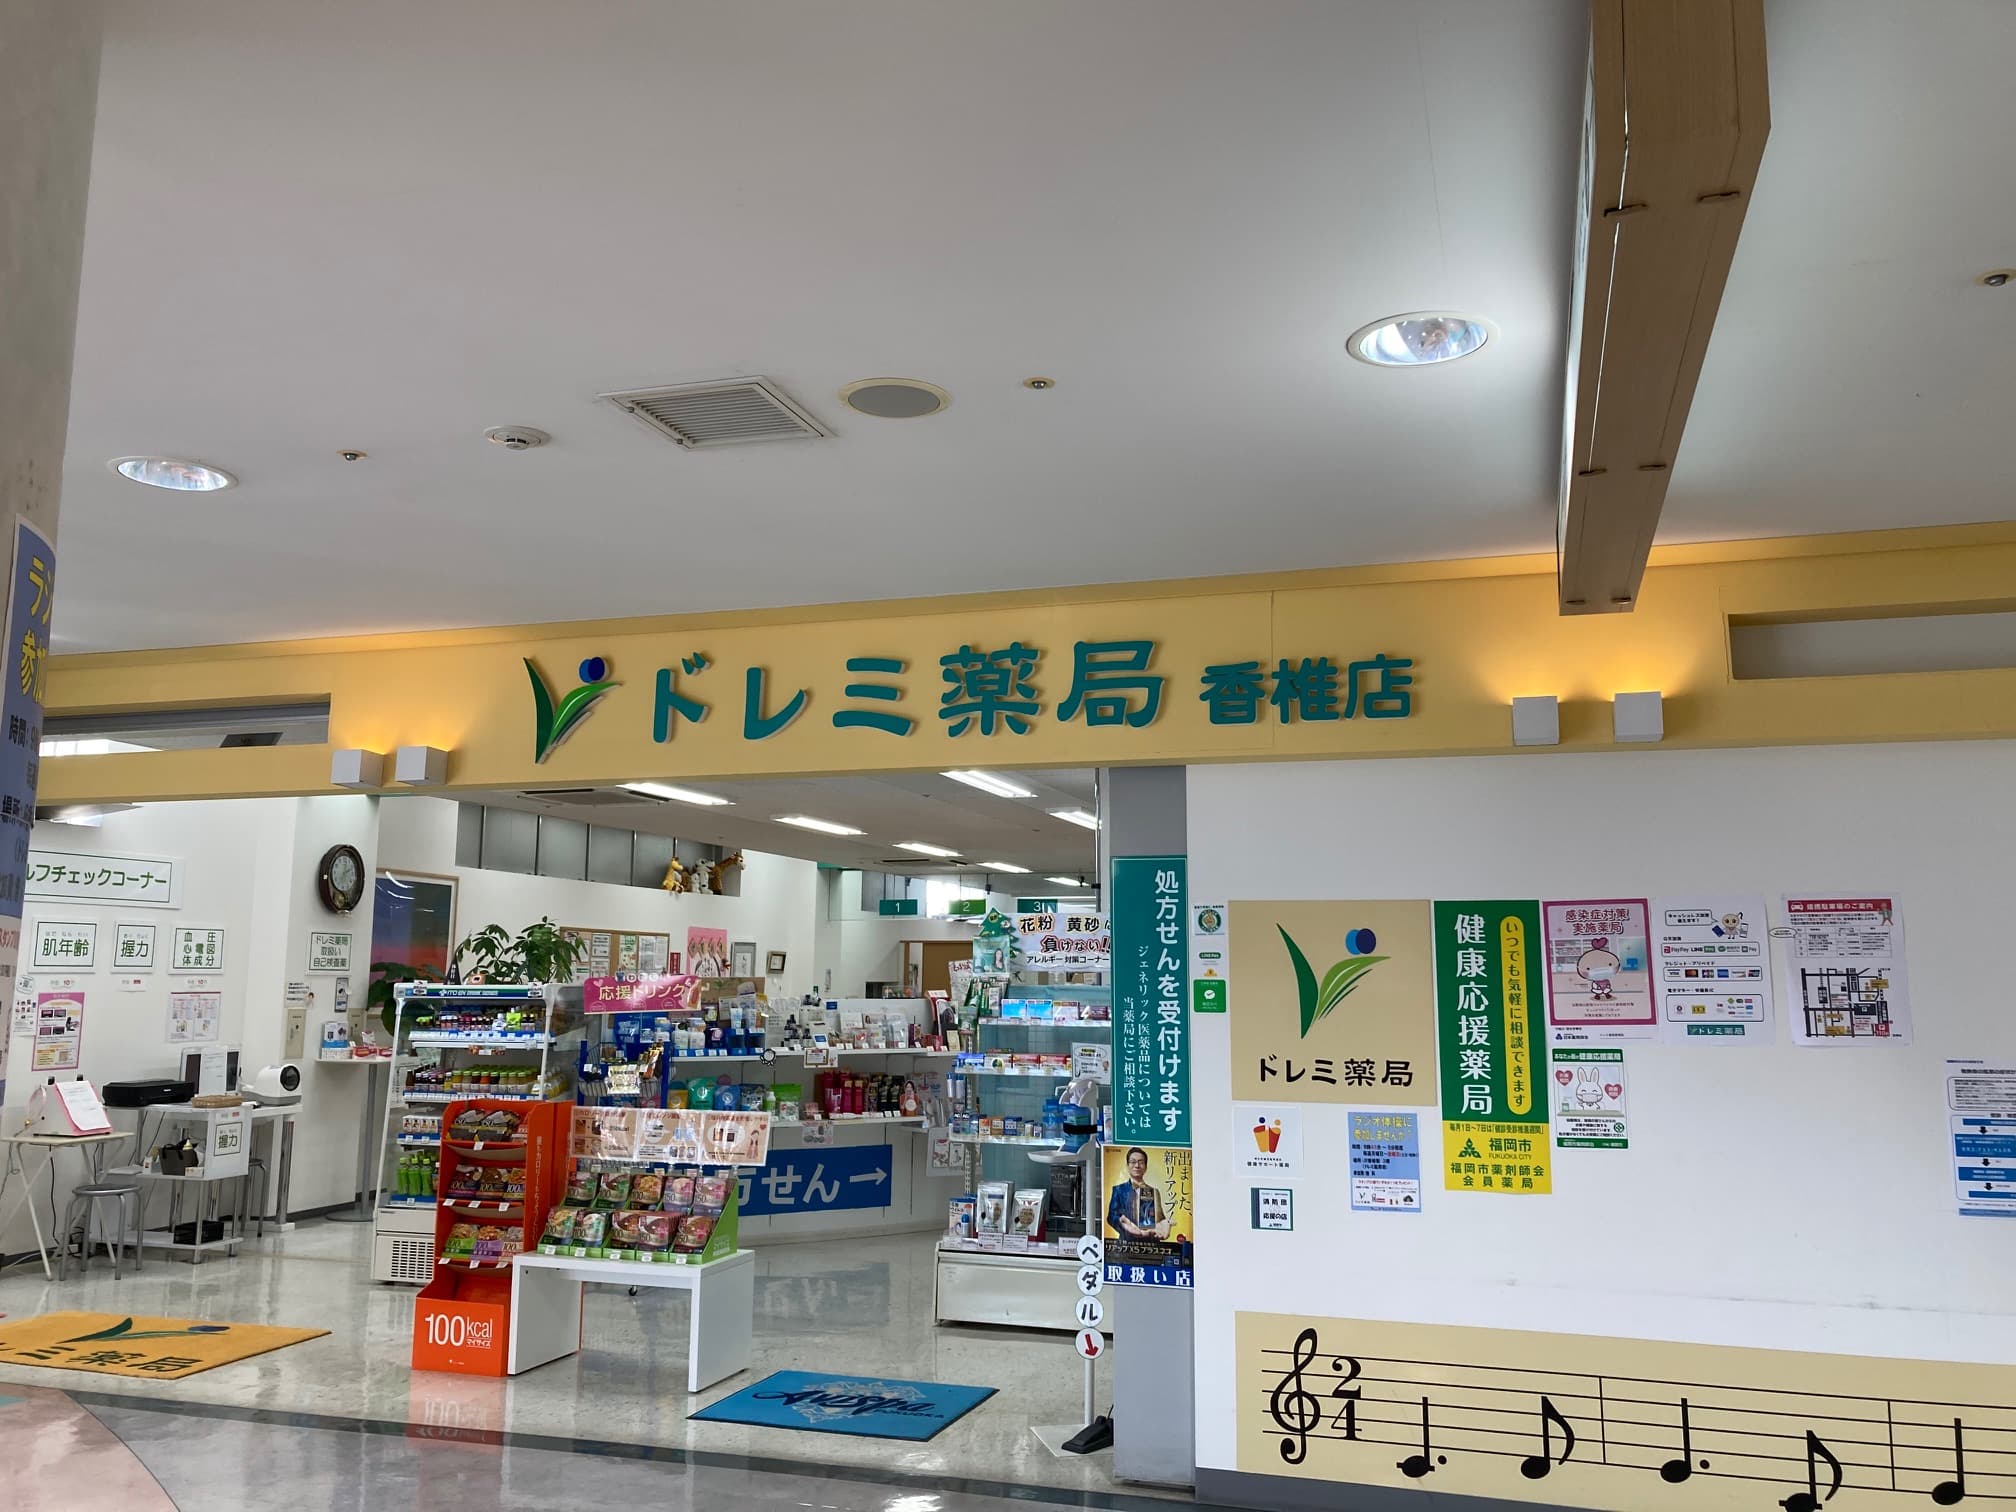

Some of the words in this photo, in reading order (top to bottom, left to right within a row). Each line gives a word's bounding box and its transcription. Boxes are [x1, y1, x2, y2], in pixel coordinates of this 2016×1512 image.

[653, 640, 1165, 743] ドレミ薬局
[1199, 653, 1413, 726] 香椎店
[895, 902, 900, 913] 1
[963, 902, 970, 912] 2
[1033, 902, 1041, 912] 3
[1565, 908, 1629, 922] 感染症対策
[1020, 916, 1053, 933] 花粉
[1573, 922, 1624, 935] 実施薬局
[42, 938, 89, 957] 肌年齢
[120, 939, 149, 958] 握力
[183, 943, 216, 955] 心電図
[182, 955, 215, 966] 体成分
[599, 983, 684, 1001] 応援ドリンク
[1155, 870, 1182, 1132] 処方せんを受付けます
[1454, 913, 1492, 1115] 健康応援薬局
[1505, 922, 1527, 1107] いつでも気軽に相談できます
[1137, 945, 1151, 1128] ジェネリック医薬品については
[1123, 997, 1136, 1134] 当薬局にご相談下さい。
[1260, 1054, 1413, 1087] ドレミ薬局
[1489, 1138, 1531, 1152] 福岡市
[1450, 1162, 1544, 1176] 福岡市薬剤師会
[1463, 1175, 1533, 1188] 会員薬局
[1081, 1244, 1099, 1321] ペダル
[1108, 1265, 1190, 1286] 取扱い店
